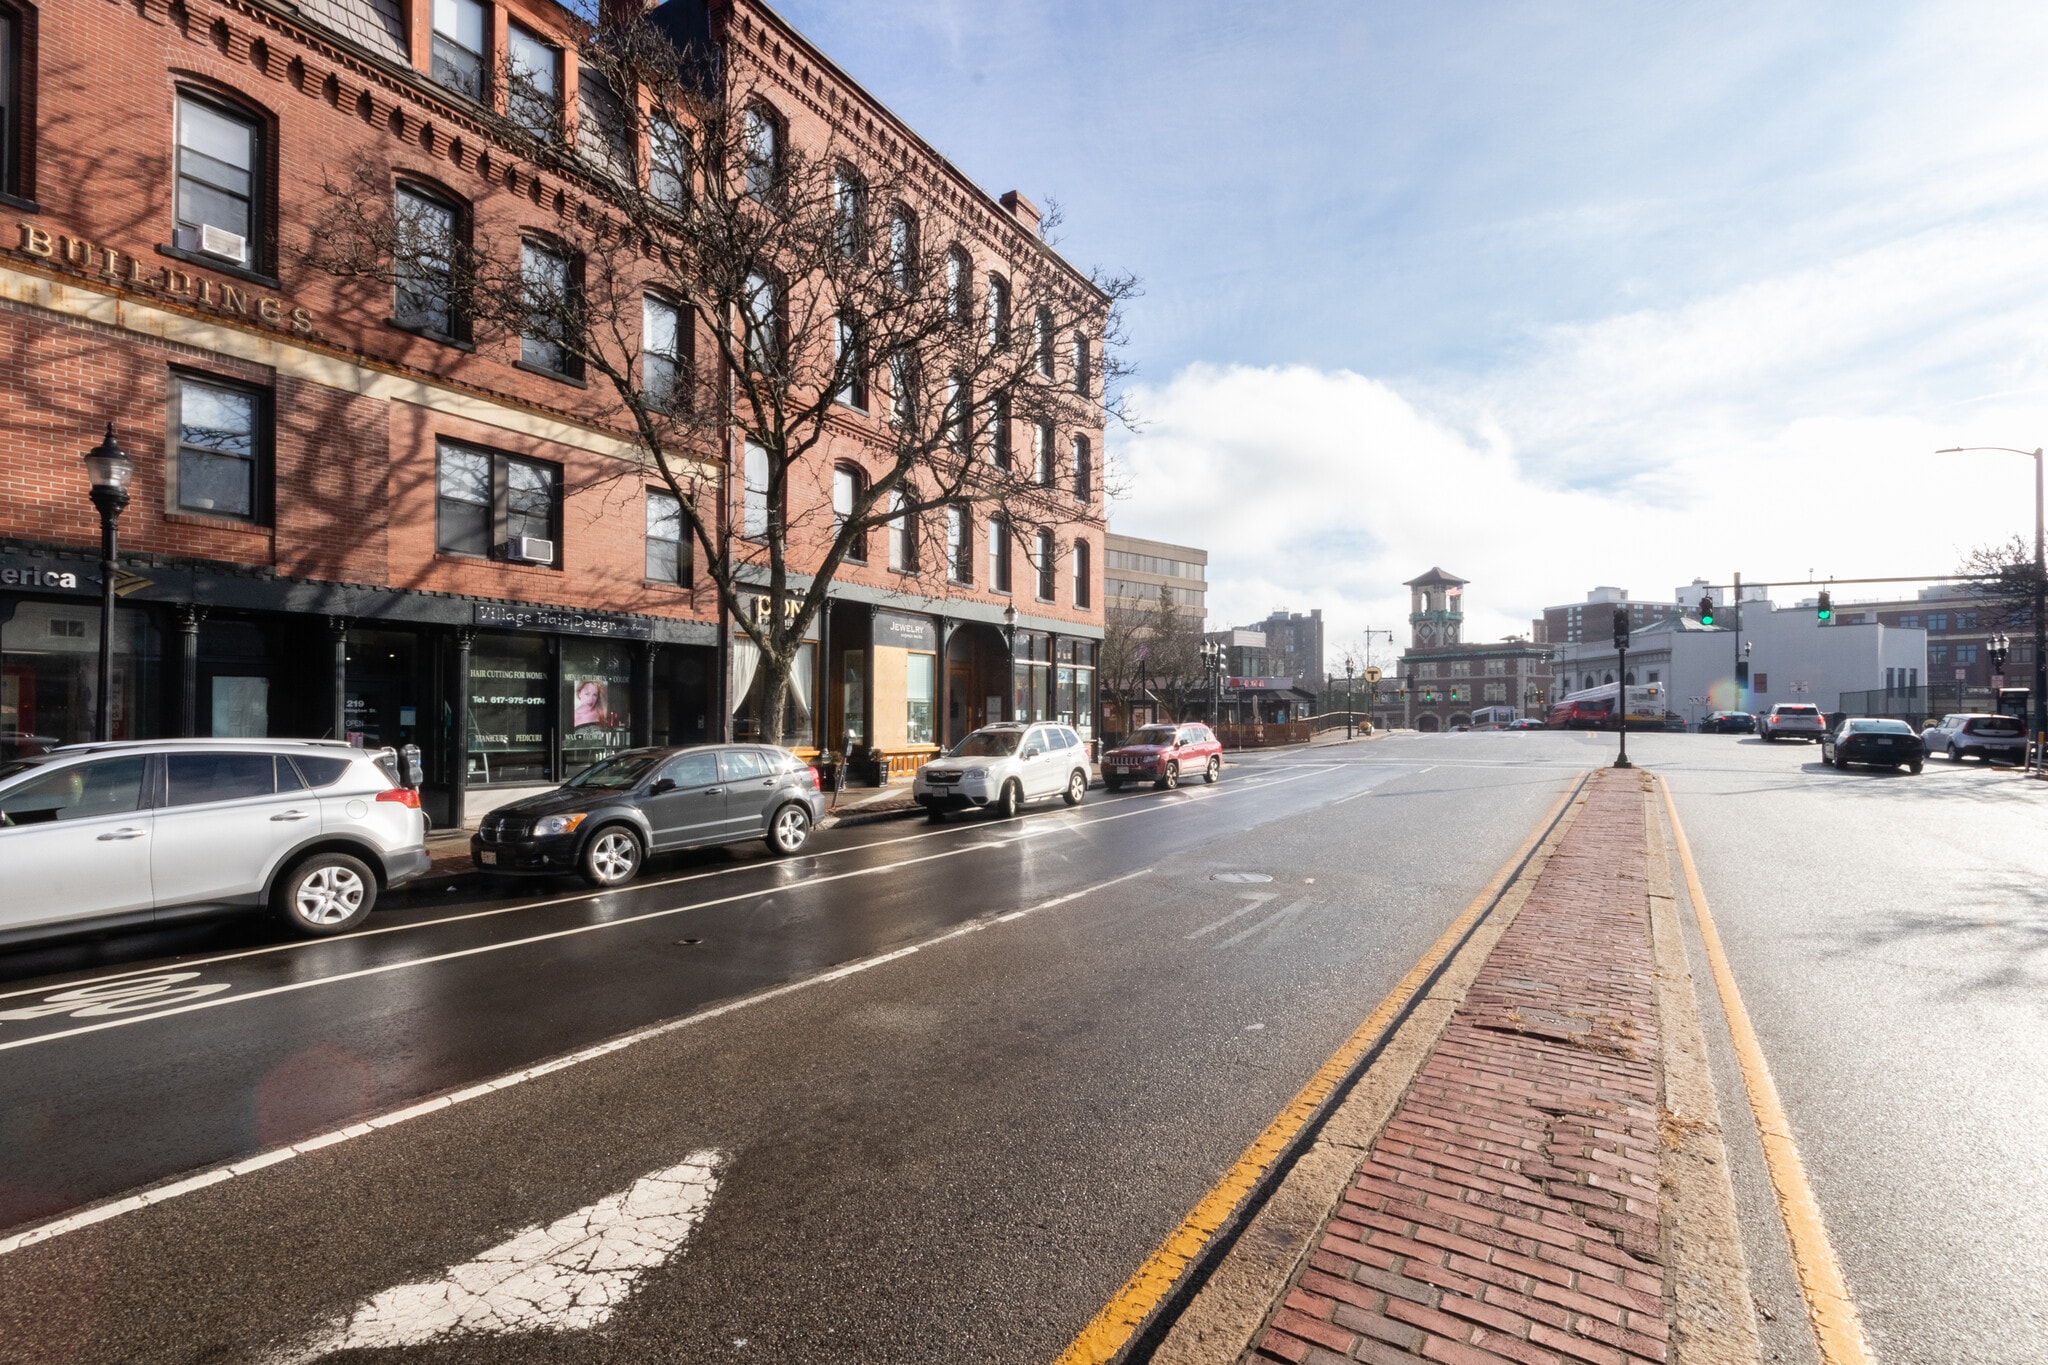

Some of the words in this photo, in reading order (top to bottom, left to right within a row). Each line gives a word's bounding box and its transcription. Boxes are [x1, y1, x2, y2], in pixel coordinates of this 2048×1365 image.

[479, 606, 532, 627] Village
[537, 611, 570, 626] Hair
[574, 614, 617, 634] Design
[470, 669, 487, 678] HAIR
[487, 670, 514, 679] CUTTING
[514, 671, 526, 679] FOR
[1367, 670, 1379, 681] T
[346, 699, 365, 708] 219
[472, 695, 488, 704] Tel.
[490, 696, 546, 705] 617-975-0174
[515, 734, 543, 742] PEDICURE
